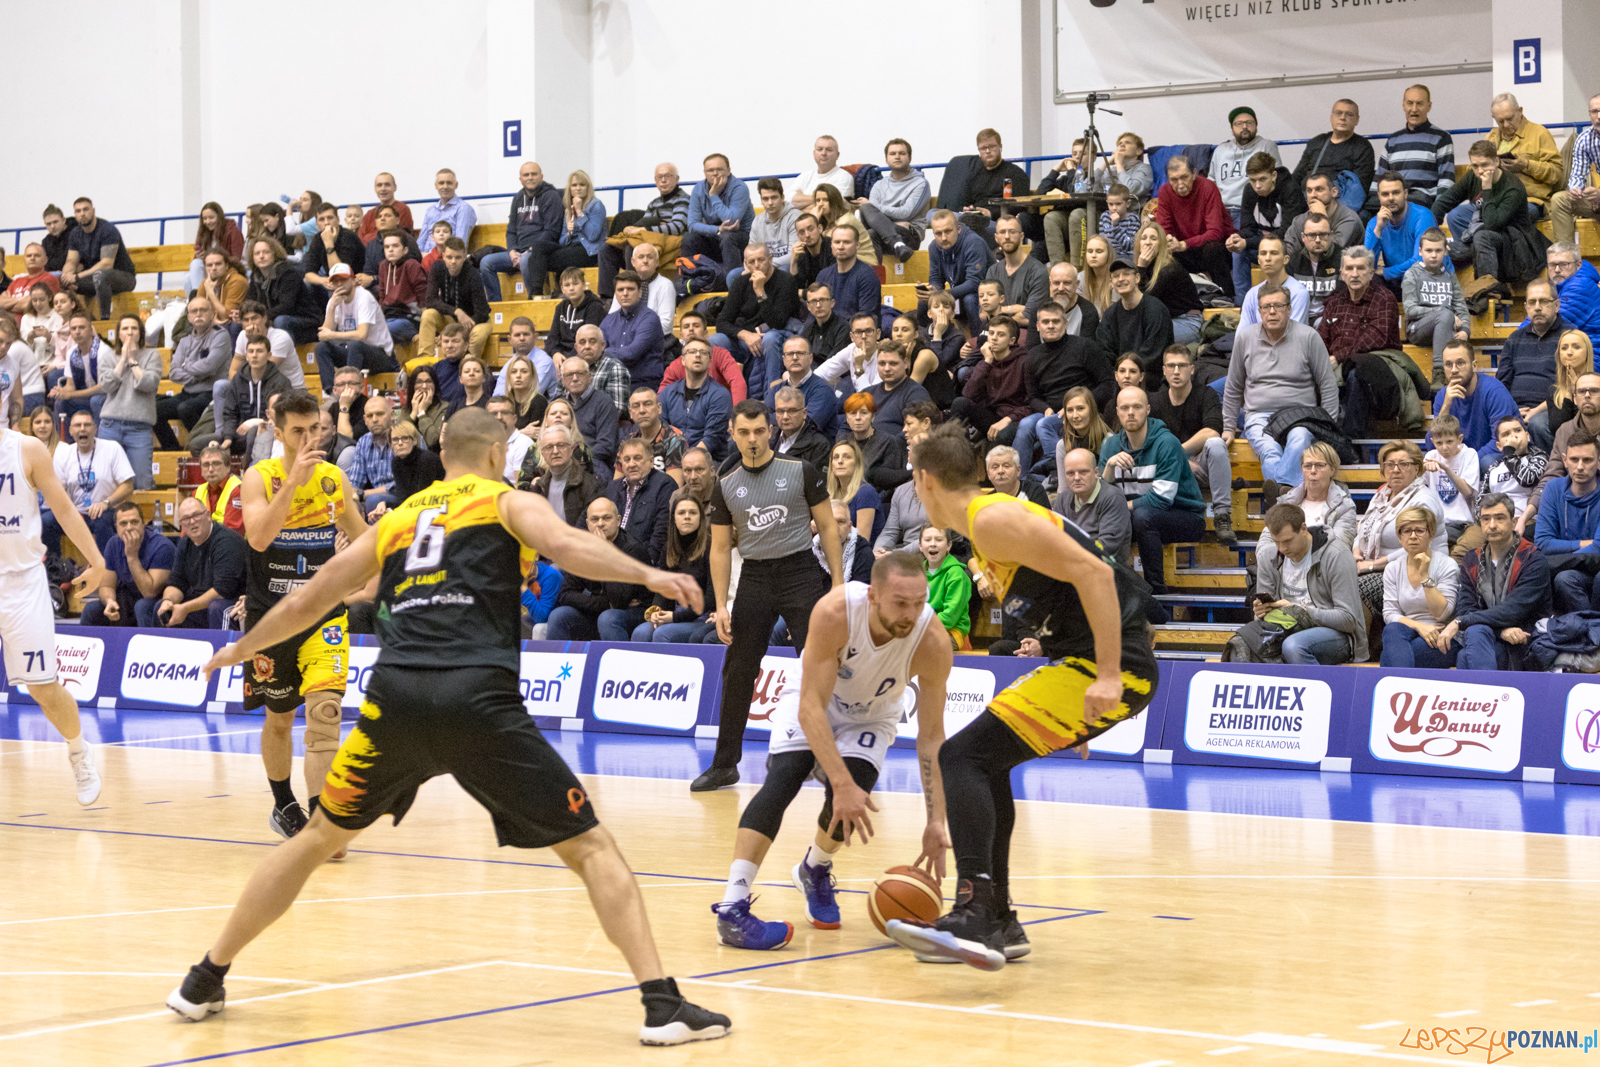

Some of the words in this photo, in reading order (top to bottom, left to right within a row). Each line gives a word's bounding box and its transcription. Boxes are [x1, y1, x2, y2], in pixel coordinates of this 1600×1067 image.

[1186, 3, 1238, 22] WIĘCEJ
[1282, 0, 1321, 12] KLUB
[1518, 46, 1536, 77] B
[507, 126, 518, 151] C
[1421, 292, 1453, 306] DEPT
[0, 515, 20, 527] RM
[753, 508, 780, 526] LOTTO
[281, 530, 334, 540] RAWLPLUG
[404, 503, 448, 572] 6
[268, 562, 296, 571] CAPITAL
[269, 582, 286, 592] BDS
[431, 593, 475, 605] Polska
[23, 650, 46, 672] 71
[332, 655, 342, 674] 3
[128, 662, 200, 680] BIOFARM
[601, 679, 690, 701] BIOFARM
[874, 678, 896, 697] 0
[945, 692, 984, 702] NOSTYKA
[1212, 684, 1307, 711] HELMEX
[944, 702, 981, 713] AZOWA
[1390, 692, 1429, 735] U
[1431, 695, 1499, 717] leniwej
[1209, 713, 1303, 732] EXHIBITIONS
[1425, 712, 1501, 739] Danuty
[857, 731, 876, 748] 0
[1206, 738, 1243, 748] AGENCJA
[1245, 739, 1300, 750] REKLAMOWA
